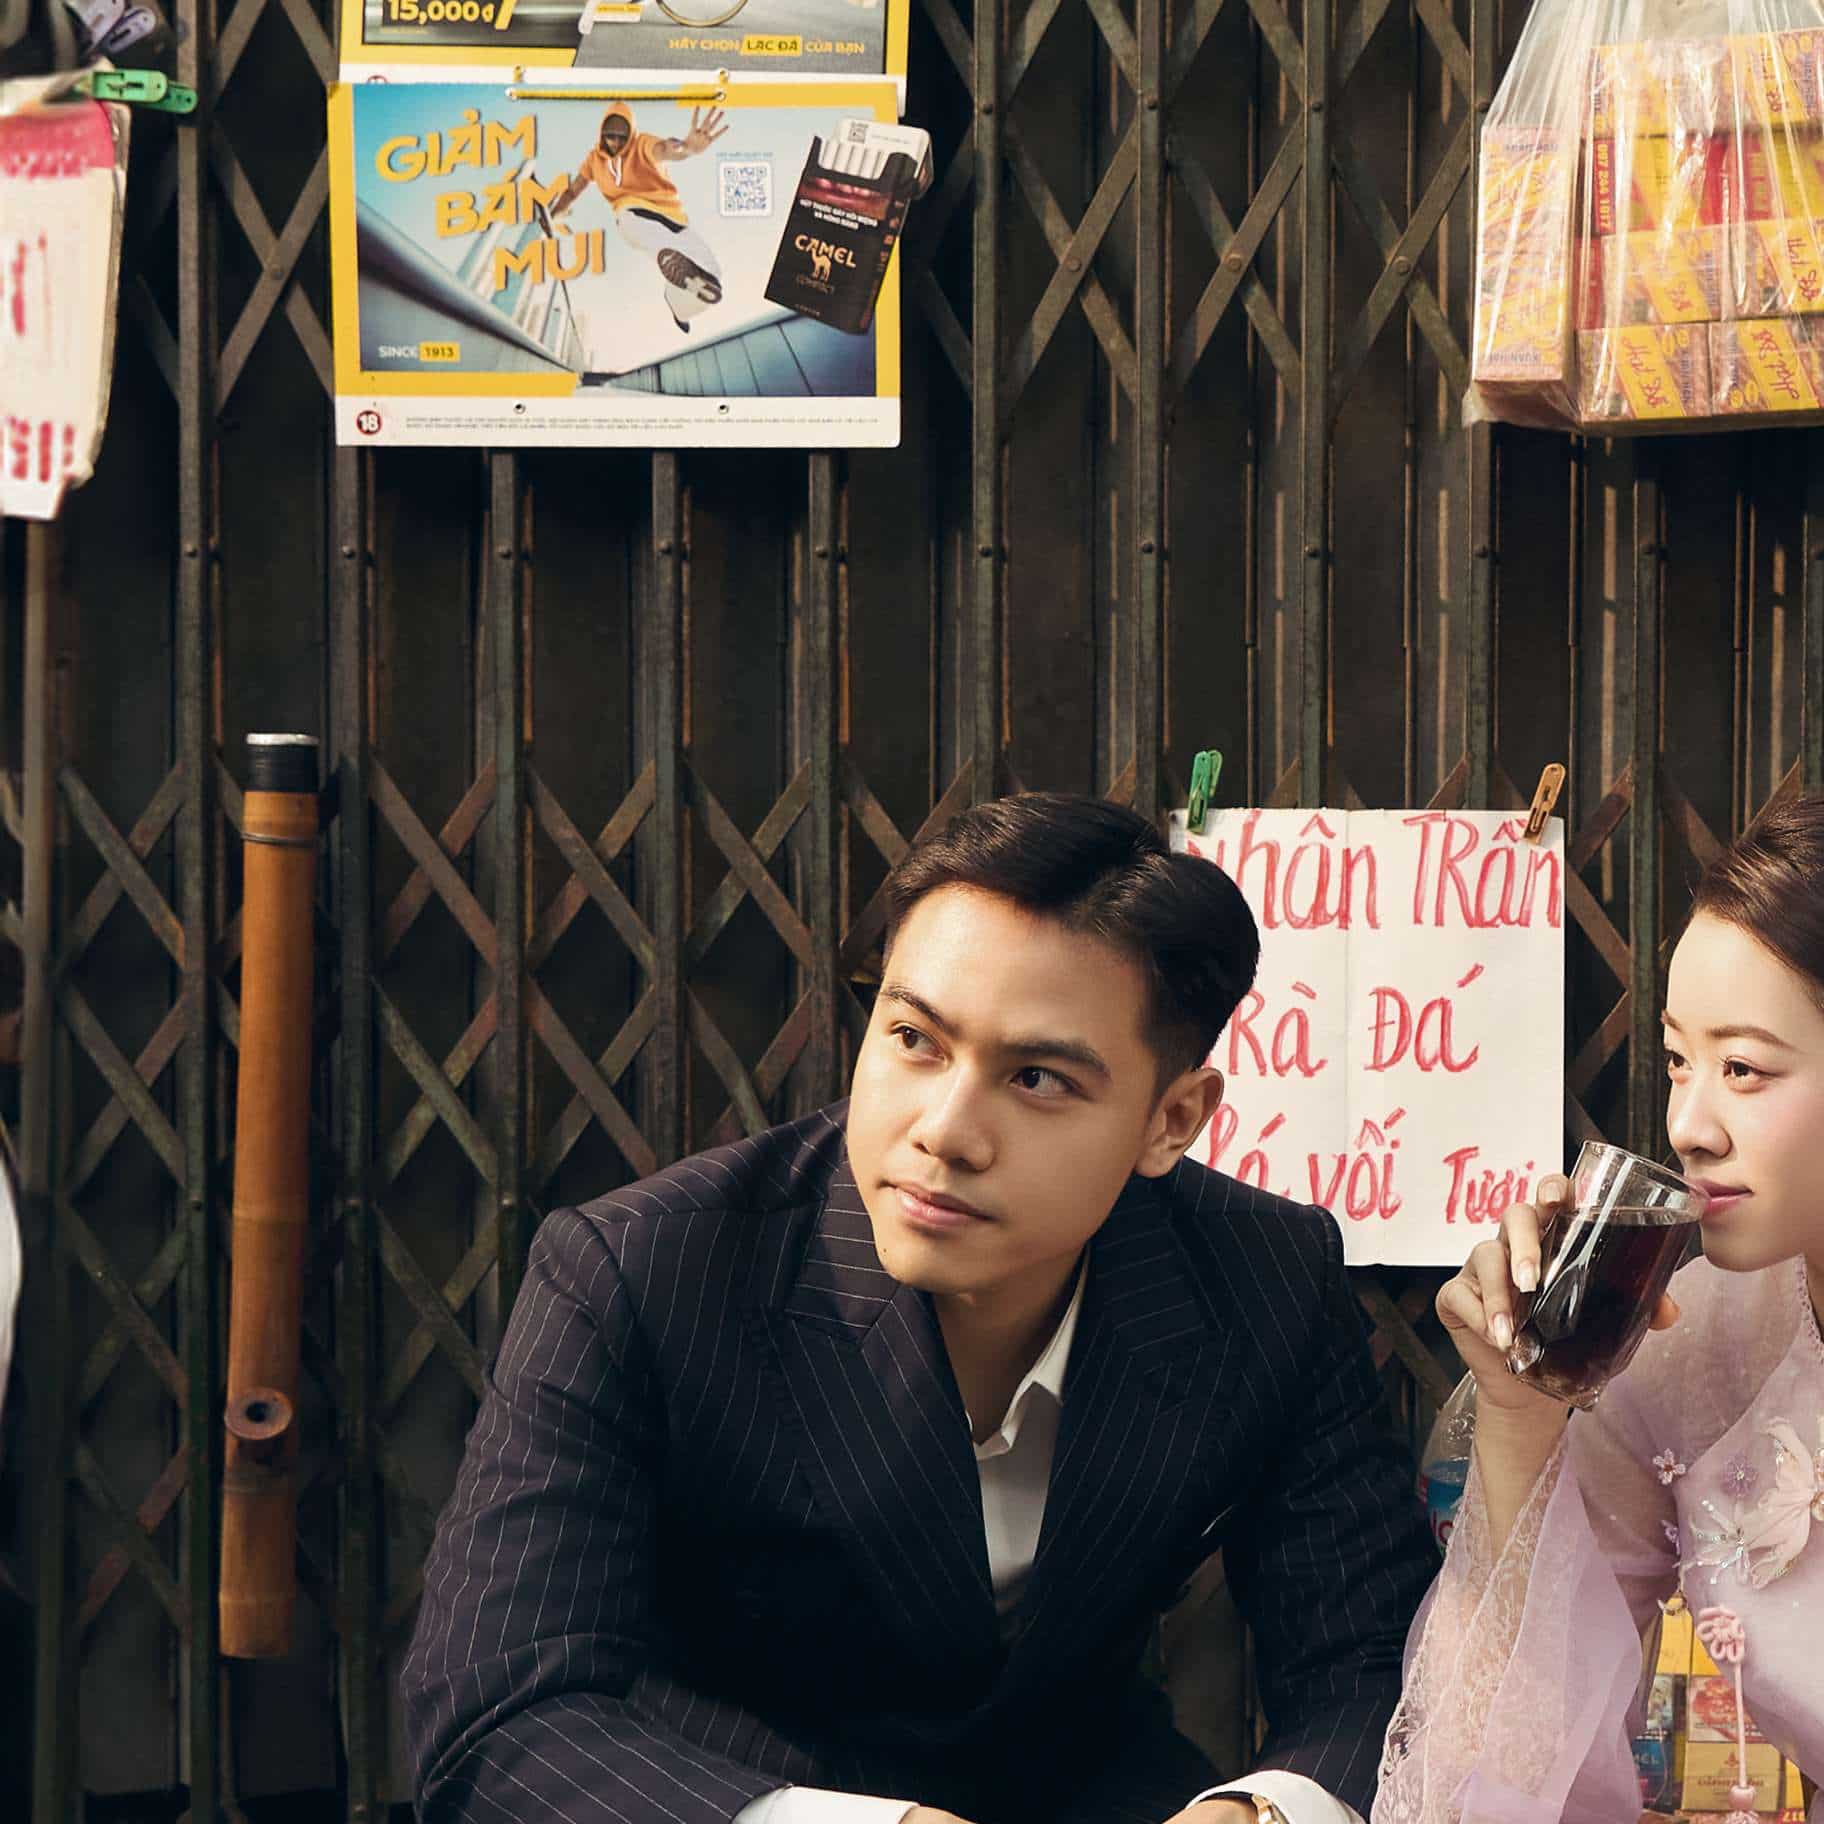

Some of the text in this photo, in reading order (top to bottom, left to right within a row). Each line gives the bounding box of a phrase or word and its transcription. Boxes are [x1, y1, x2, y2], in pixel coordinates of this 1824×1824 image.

[375, 107, 538, 183] GIẢM
[494, 224, 606, 291] MÙI
[794, 234, 857, 268] CAMEL
[378, 344, 455, 359] SINCE 1913
[359, 413, 379, 432] 18
[1203, 963, 1484, 1078] Rà Đá
